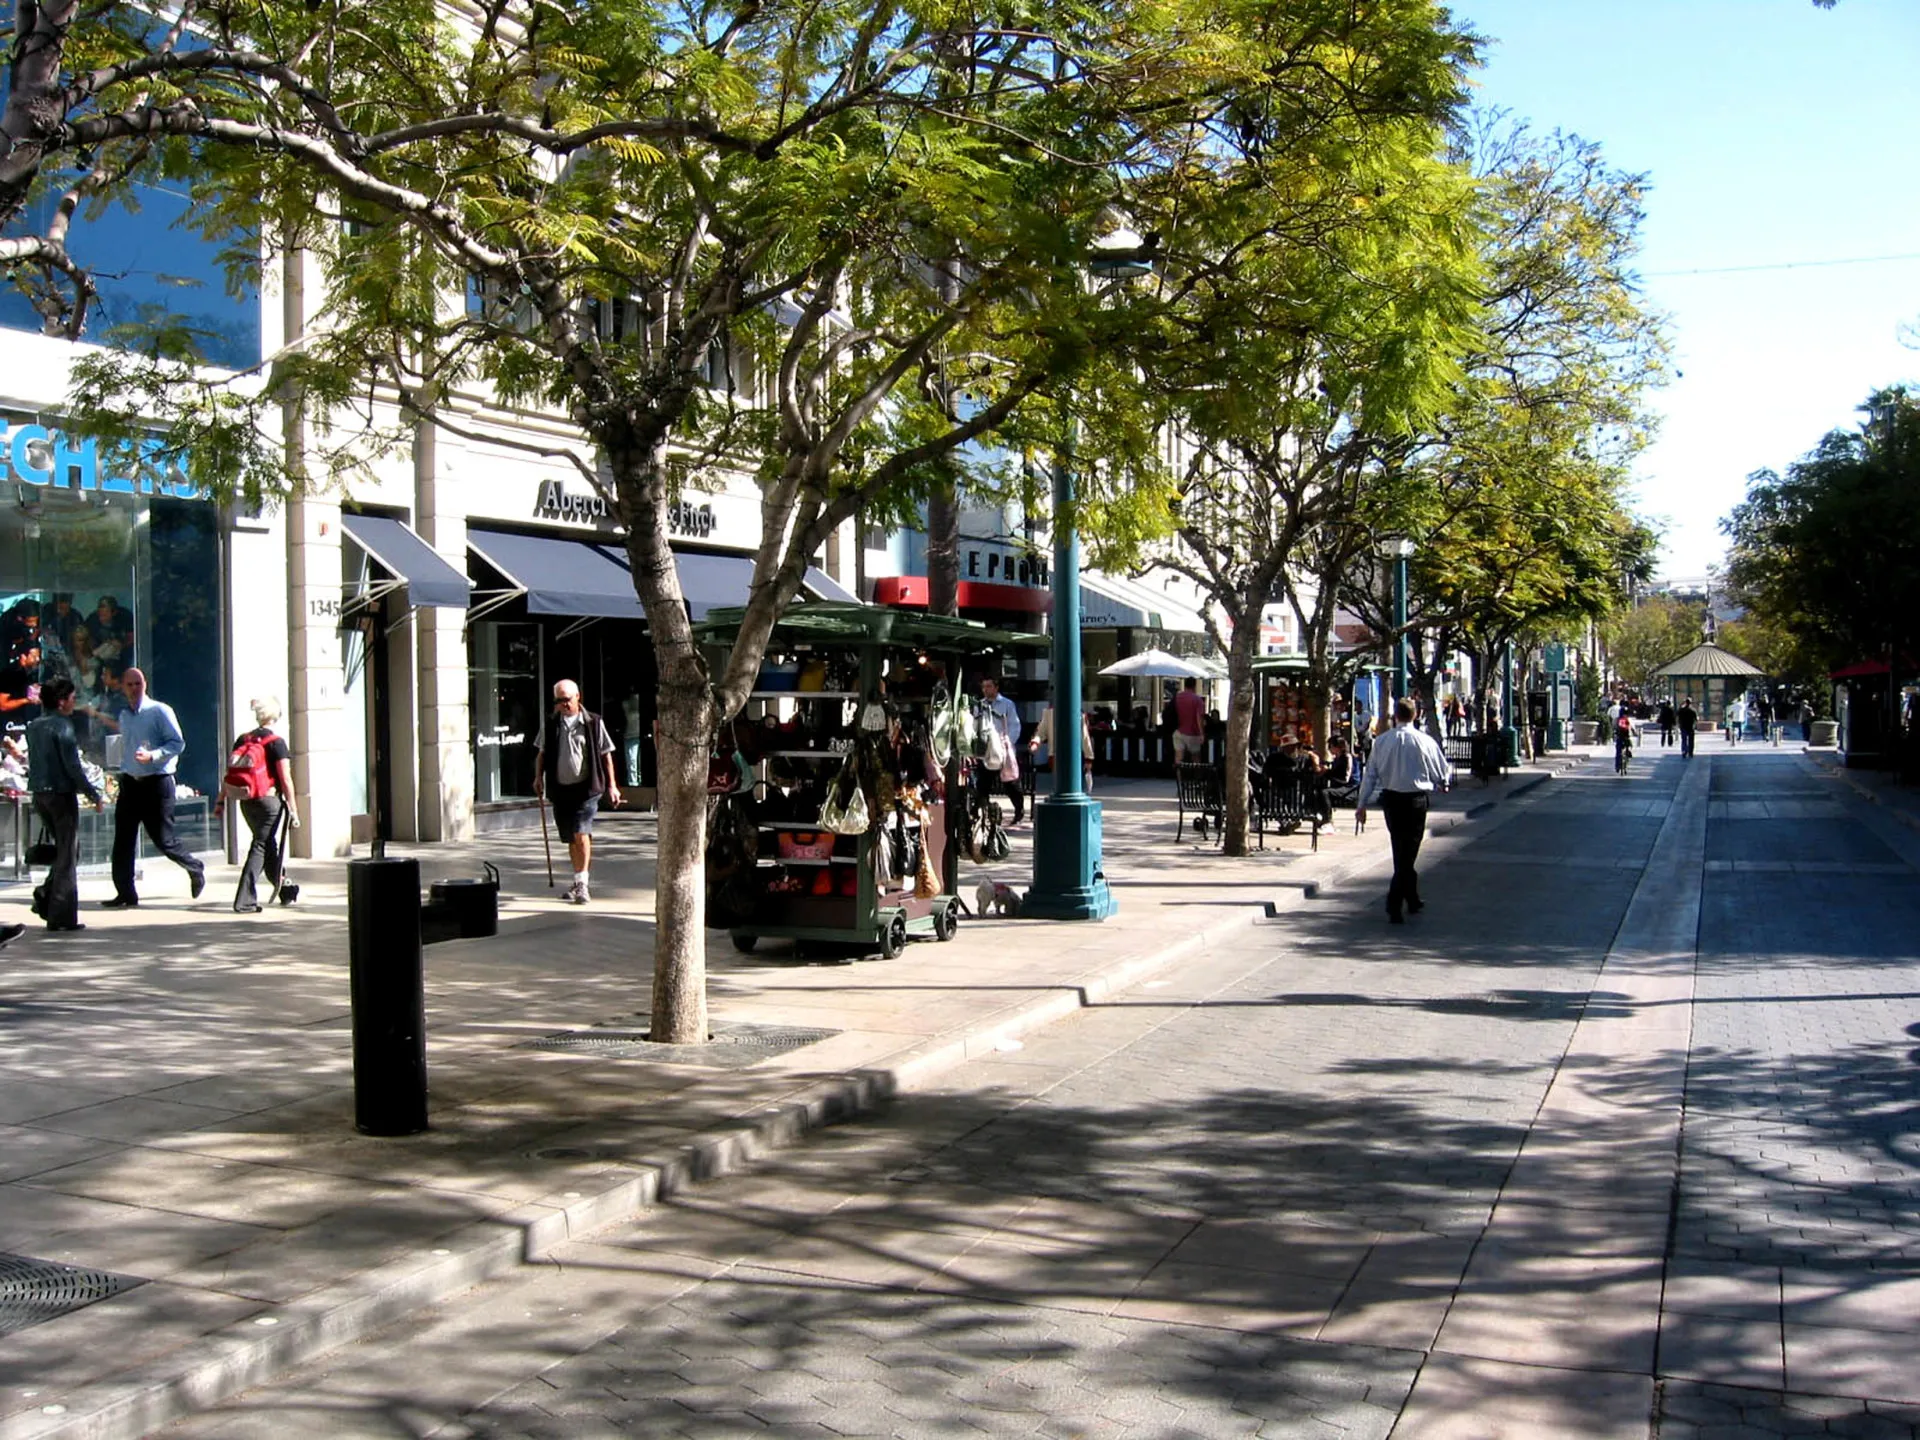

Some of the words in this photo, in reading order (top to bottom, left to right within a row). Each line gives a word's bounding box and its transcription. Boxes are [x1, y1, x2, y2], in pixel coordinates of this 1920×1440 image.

[0, 417, 201, 499] CHERS
[680, 500, 718, 530] Fitch
[310, 599, 340, 617] 1345
